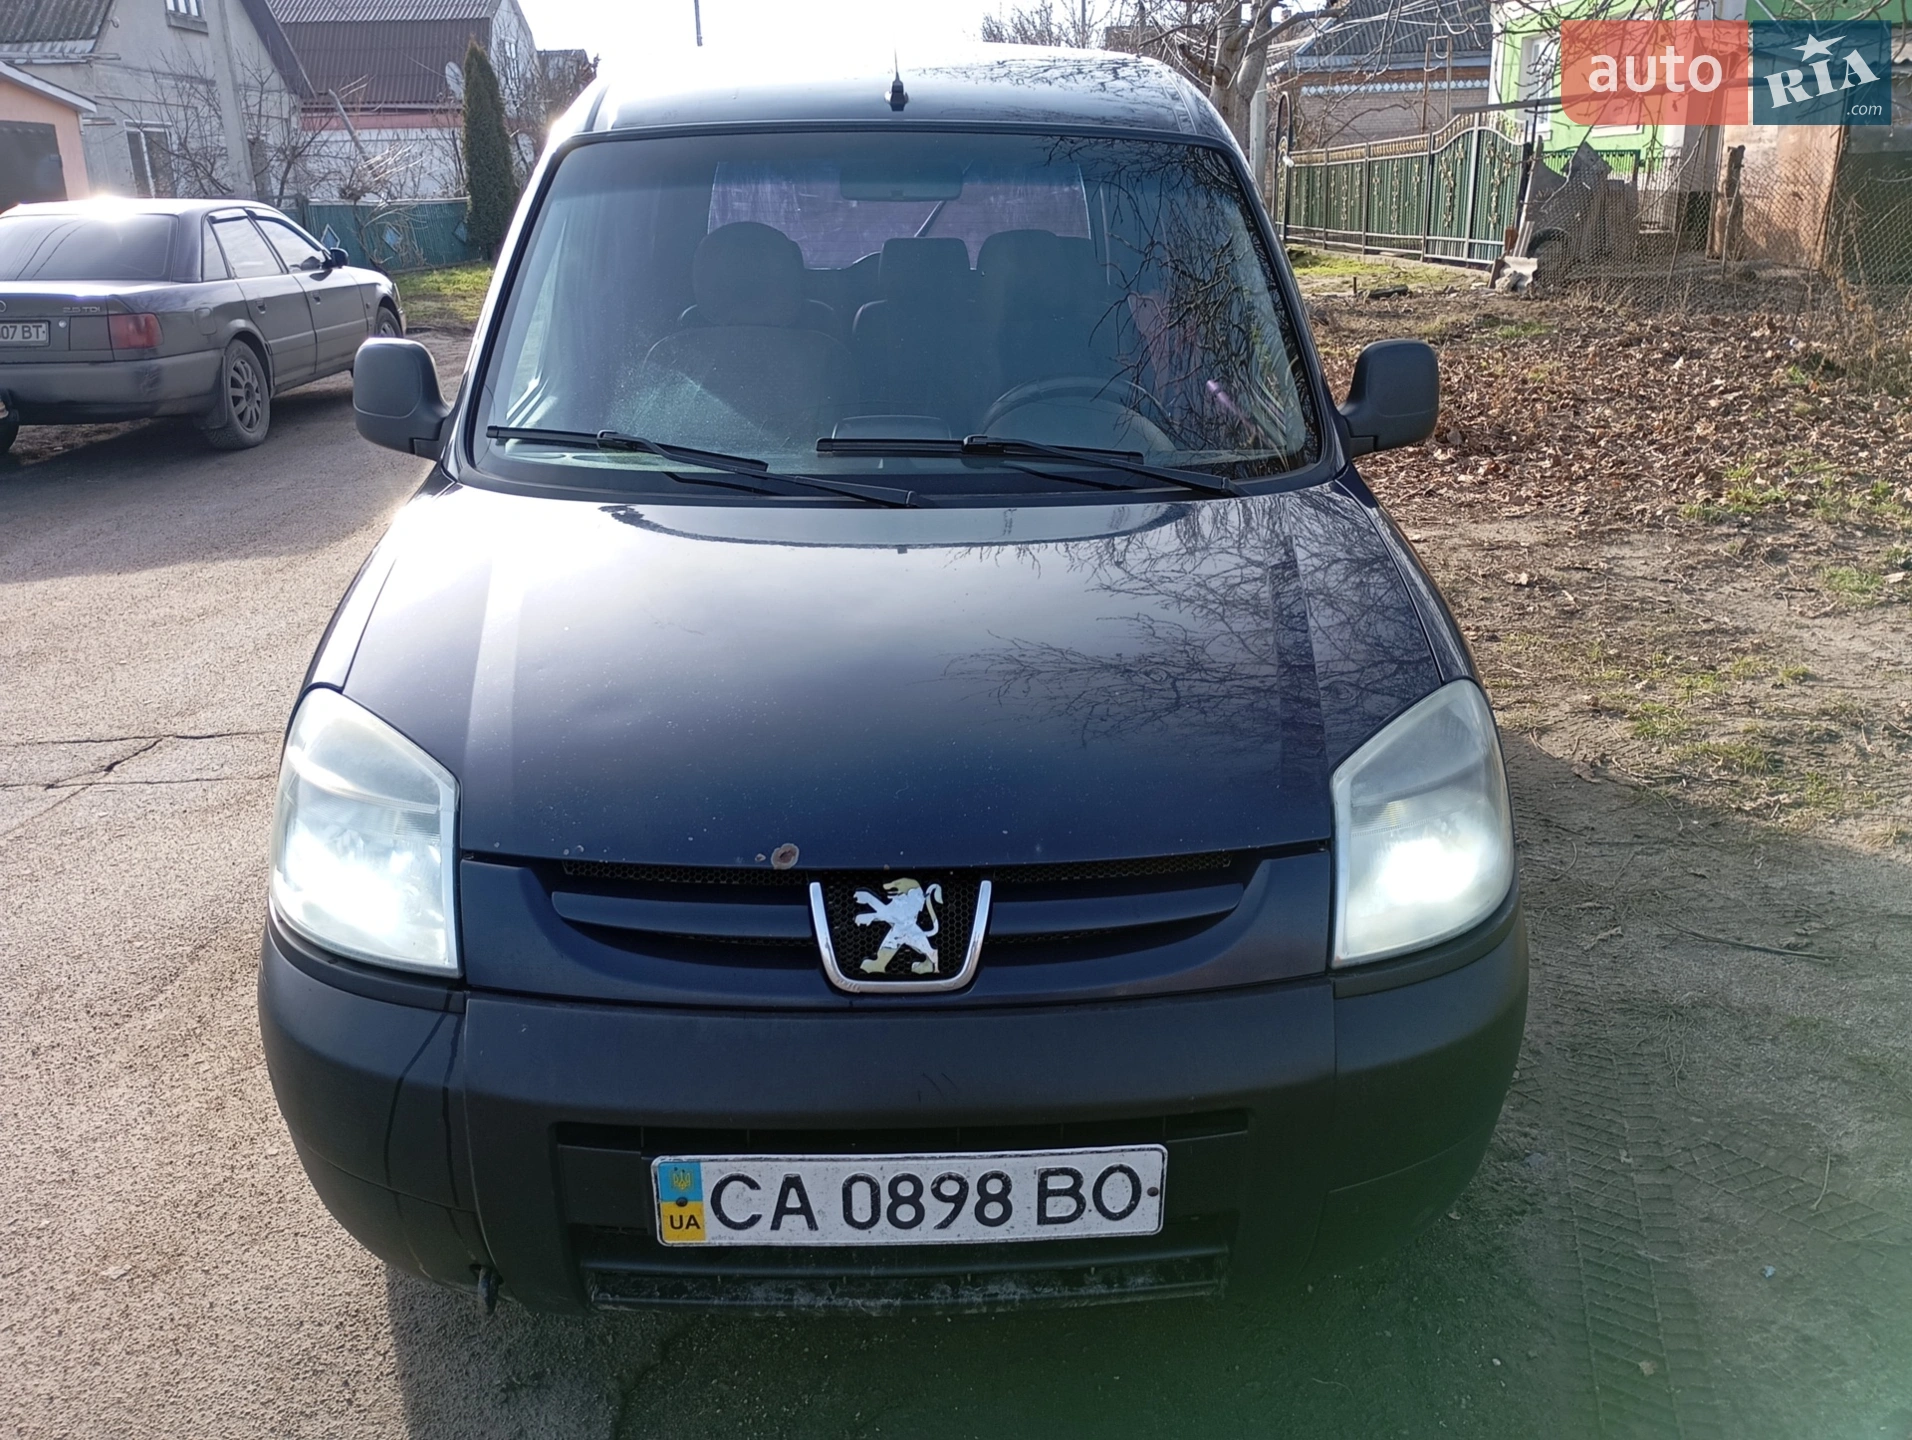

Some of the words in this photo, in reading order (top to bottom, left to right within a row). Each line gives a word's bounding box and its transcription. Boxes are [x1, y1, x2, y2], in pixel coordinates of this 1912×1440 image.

[21, 325, 42, 340] BT
[710, 1172, 819, 1231] CA
[842, 1171, 1013, 1230] 0898
[1036, 1163, 1142, 1225] BO
[669, 1214, 701, 1230] UA
